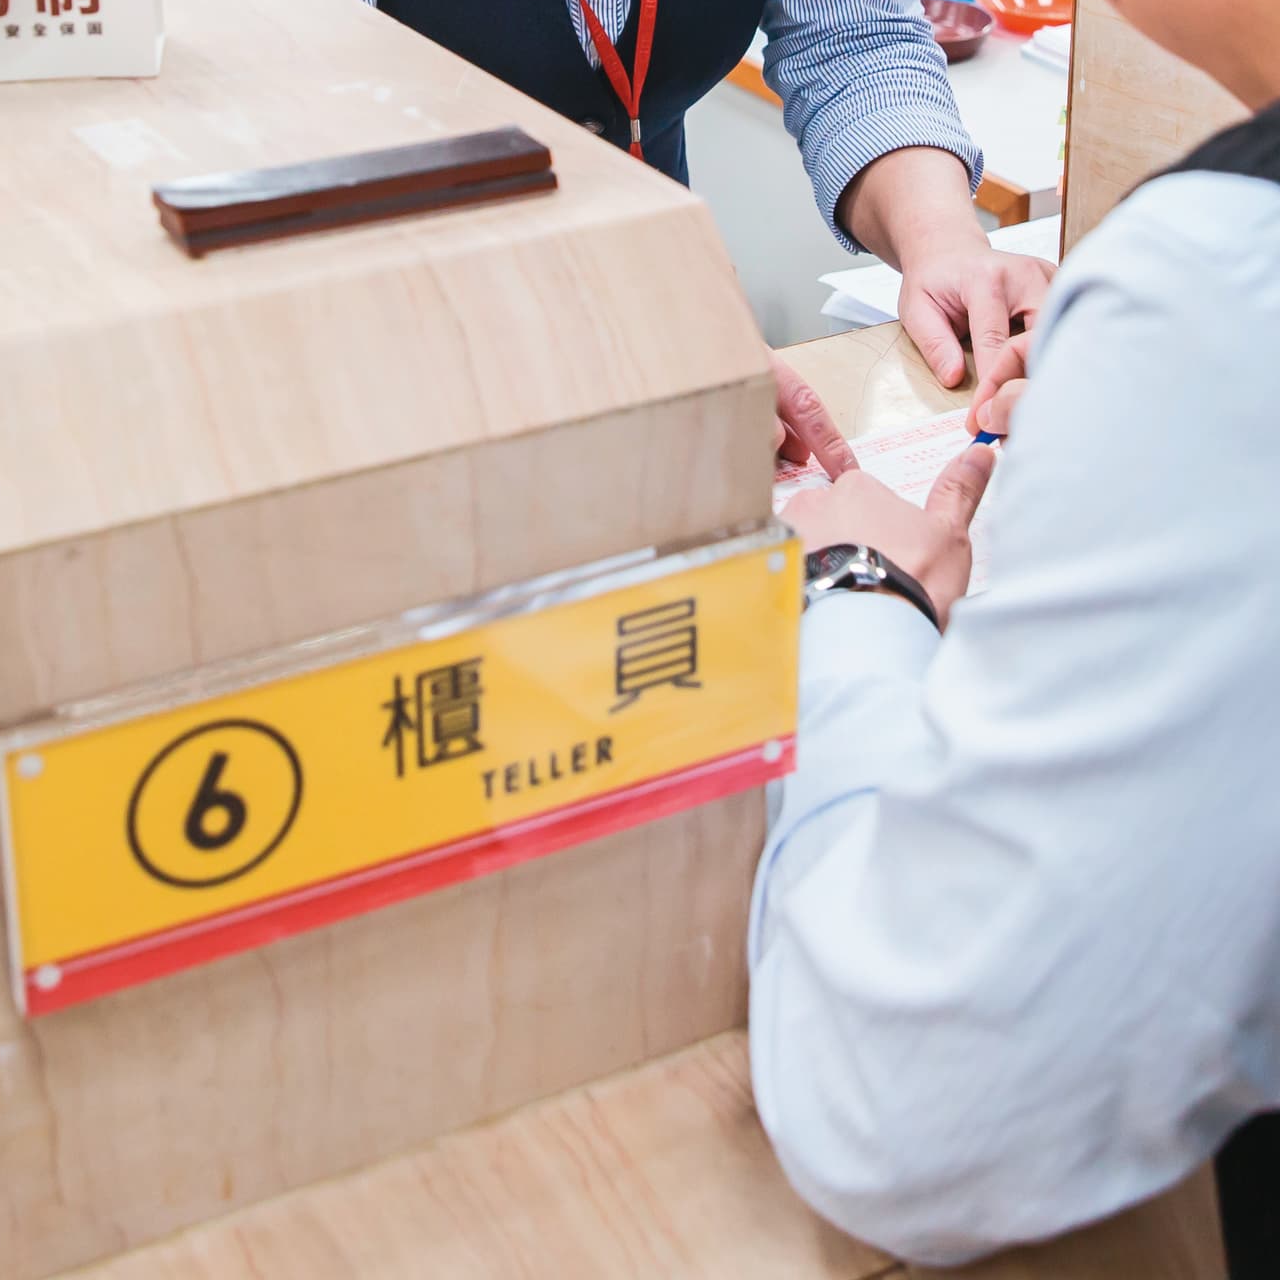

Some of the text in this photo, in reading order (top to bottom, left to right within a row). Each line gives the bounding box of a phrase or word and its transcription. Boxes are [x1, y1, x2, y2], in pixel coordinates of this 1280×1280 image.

[184, 597, 703, 850] 6 櫃員
[482, 736, 615, 800] TELLER
